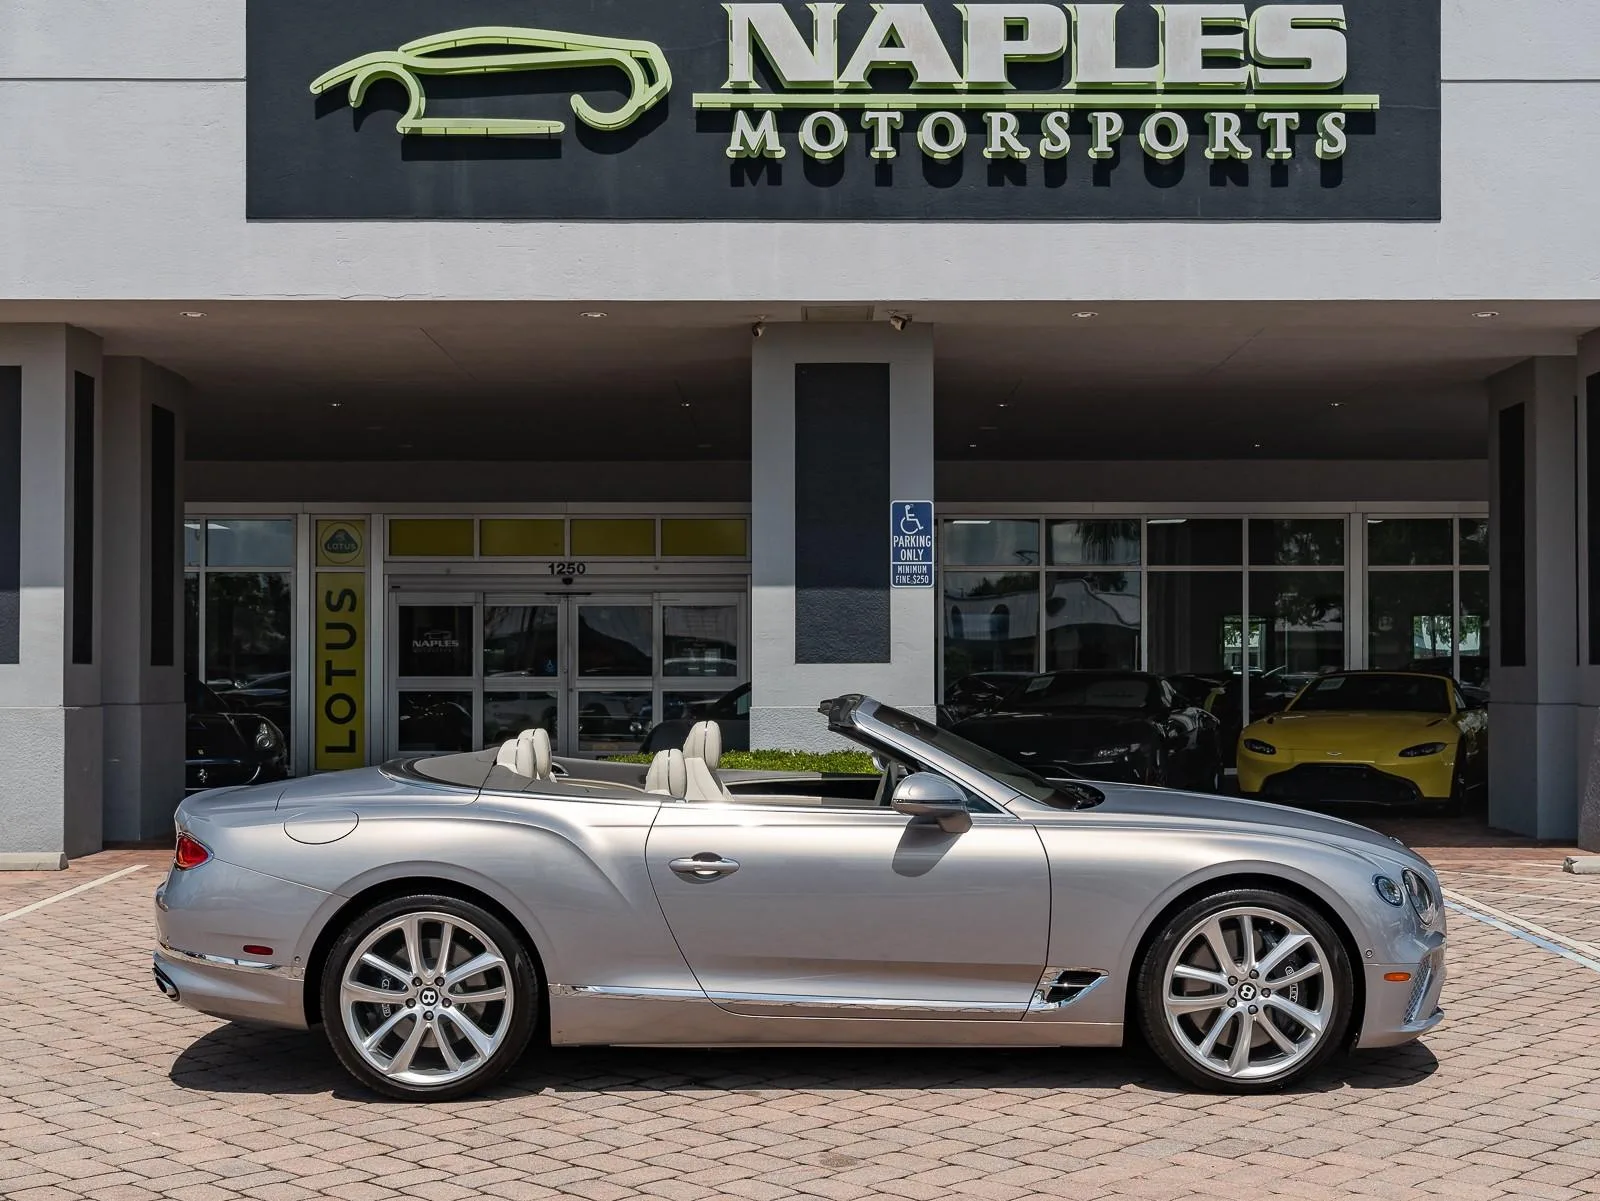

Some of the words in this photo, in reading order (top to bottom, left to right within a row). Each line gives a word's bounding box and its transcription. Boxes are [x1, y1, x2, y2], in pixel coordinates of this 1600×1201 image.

[721, 3, 1347, 90] NAPLES
[726, 110, 1347, 160] MOTORSPORTS
[327, 543, 357, 551] LOTUS
[893, 535, 932, 548] PARKING
[900, 549, 924, 561] ONLY
[548, 562, 586, 575] 1250
[897, 565, 927, 574] MINIMUM
[895, 575, 911, 584] FINE
[912, 574, 929, 584] $250
[412, 640, 459, 648] NAPLES
[325, 588, 357, 754] LOTUS
